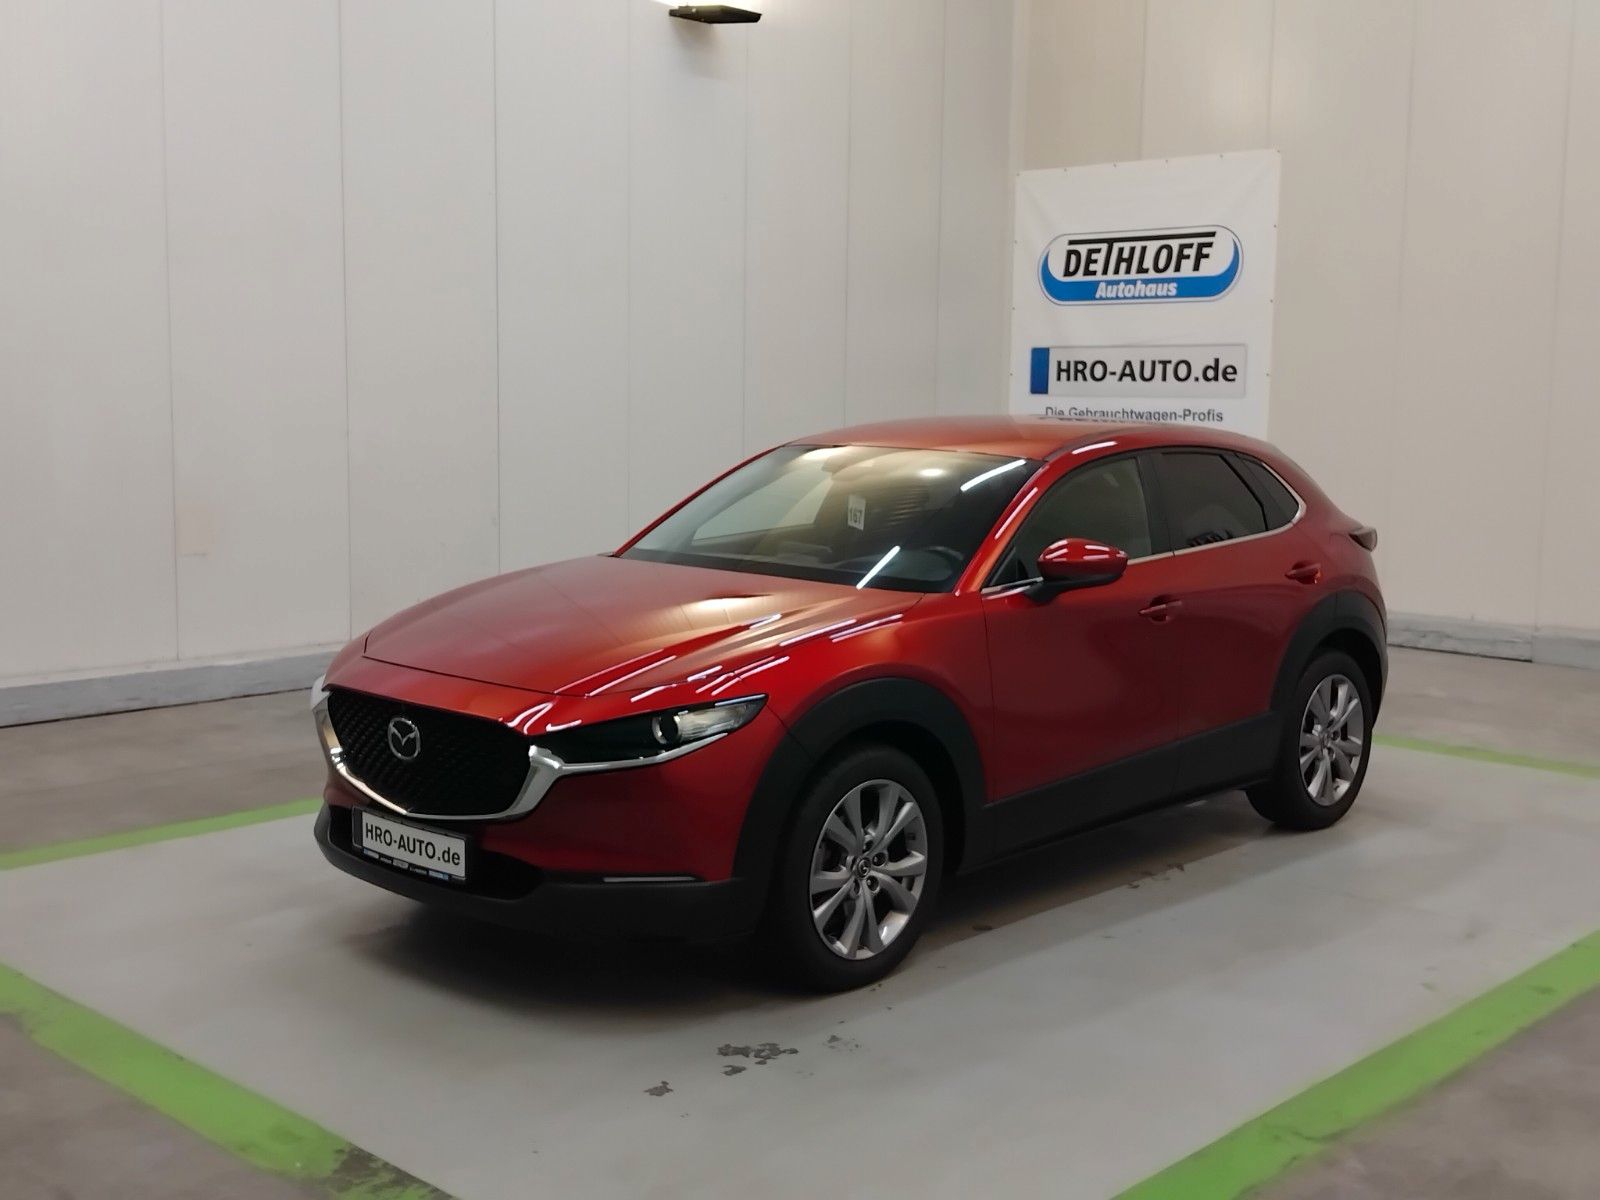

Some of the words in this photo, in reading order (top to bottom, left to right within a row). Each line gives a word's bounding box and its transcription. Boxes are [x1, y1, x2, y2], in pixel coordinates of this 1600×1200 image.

[1063, 231, 1217, 277] DETHLOFF
[1095, 281, 1178, 298] Autohaus
[1056, 358, 1238, 382] HRO-AUTO.de
[365, 822, 461, 866] HRO-AUTO.de
